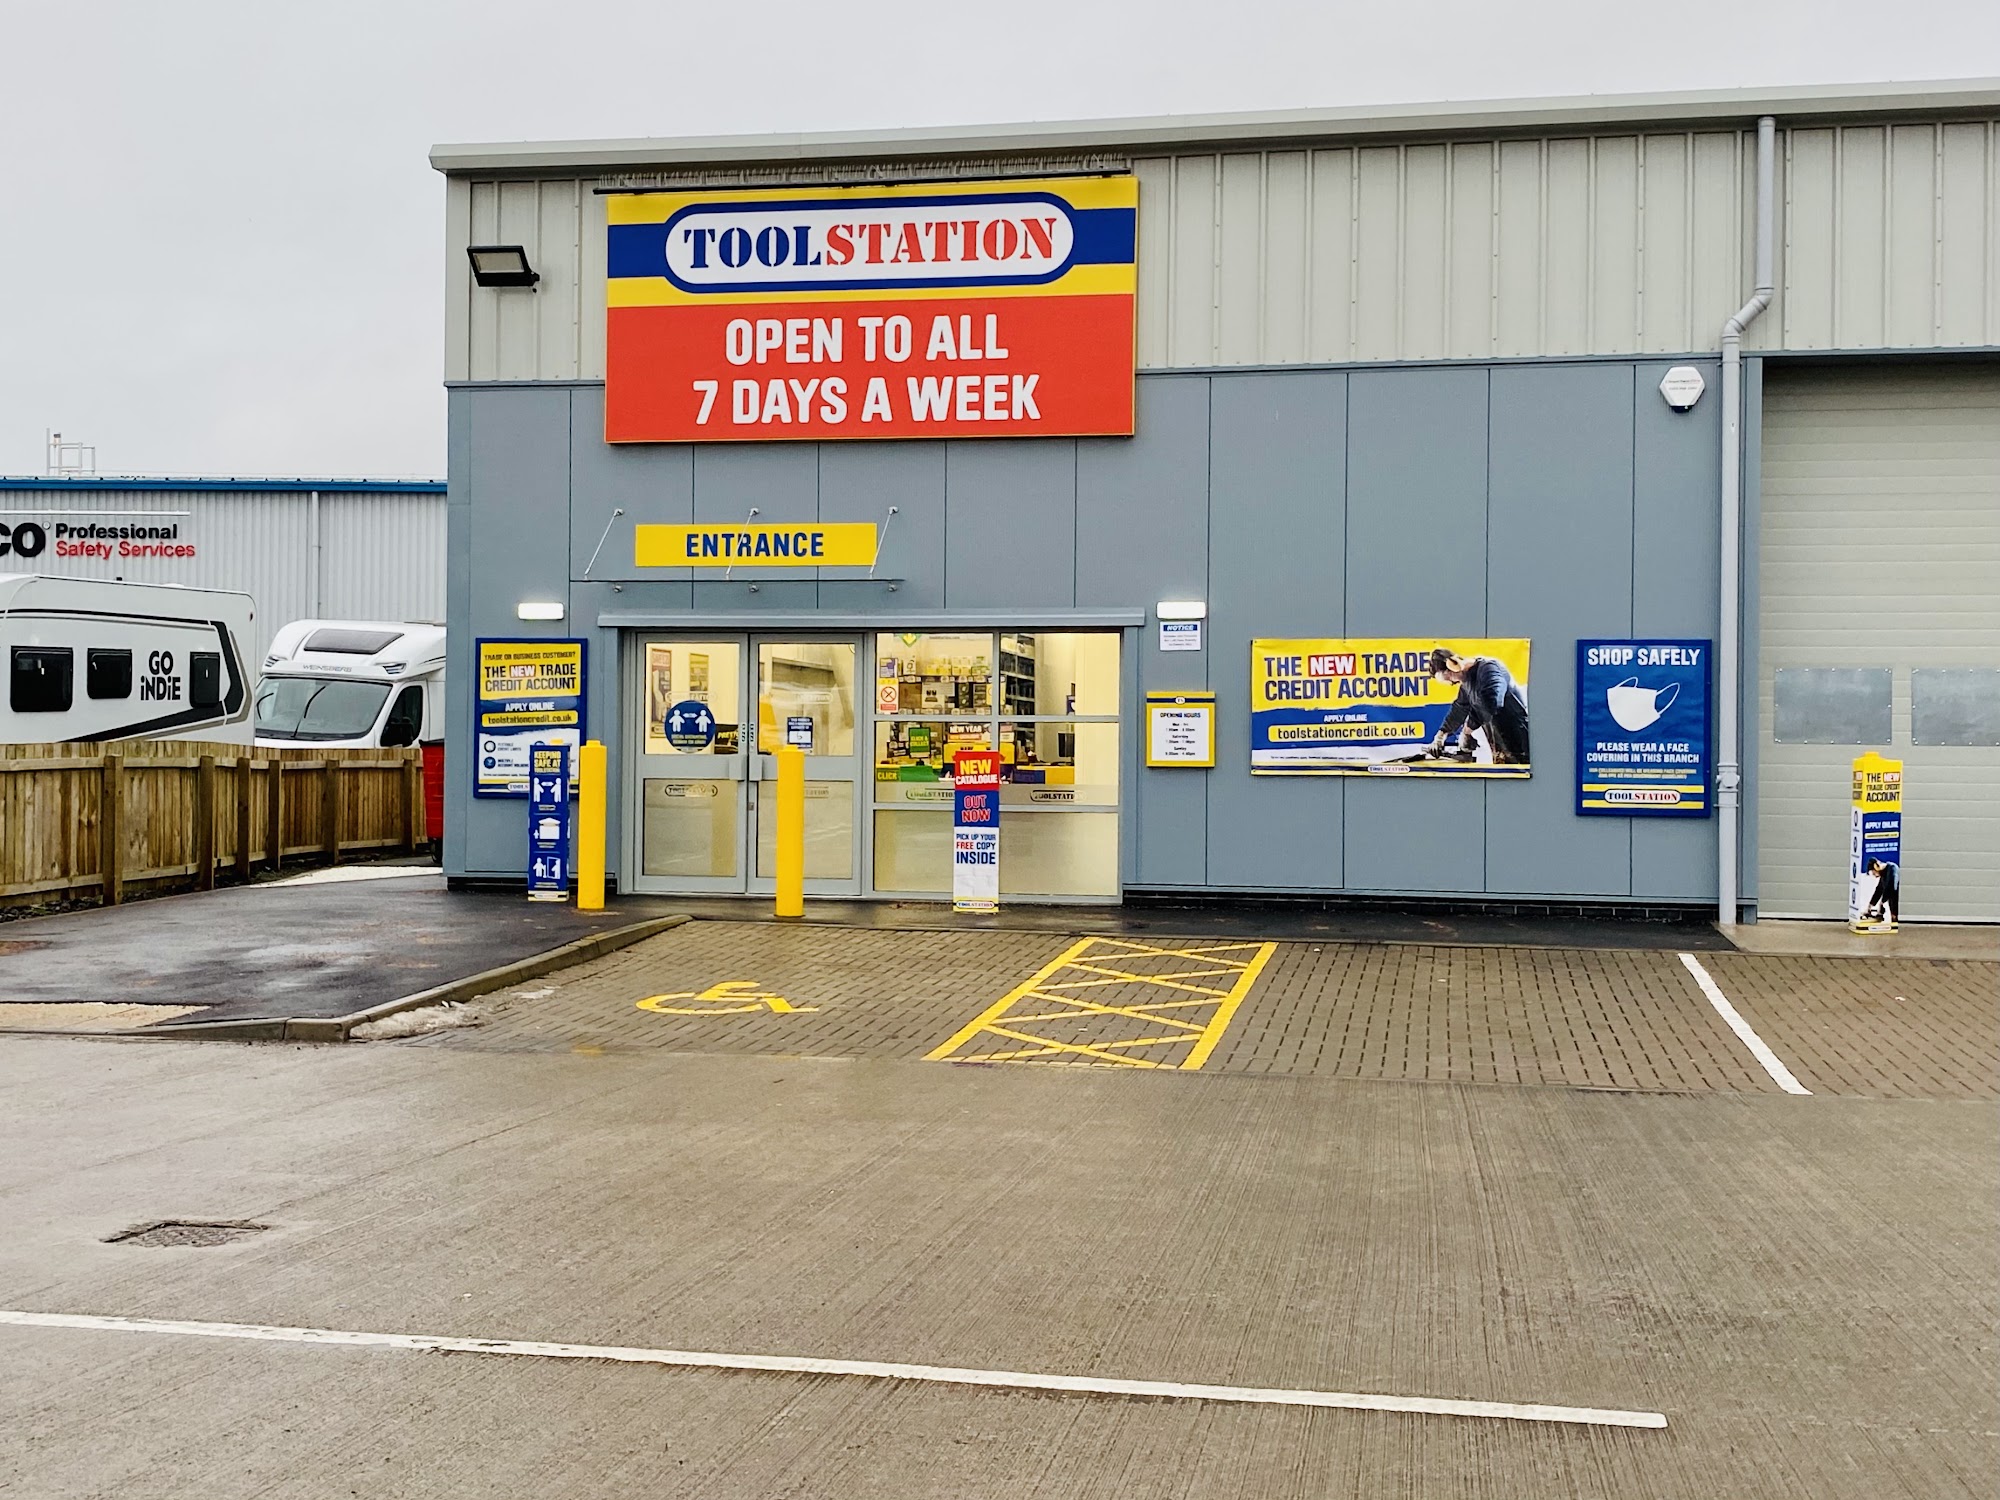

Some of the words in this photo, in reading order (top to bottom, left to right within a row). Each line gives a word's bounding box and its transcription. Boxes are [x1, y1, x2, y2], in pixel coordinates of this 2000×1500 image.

[684, 217, 1056, 268] TOOLSTATION
[725, 317, 843, 366] OPEN
[858, 315, 912, 363] TO
[926, 314, 1009, 361] ALL
[692, 380, 720, 425] 7
[732, 377, 848, 424] DAYS
[861, 377, 893, 423] A
[906, 374, 1041, 422] WEEK
[56, 523, 178, 540] Professional
[56, 541, 112, 560] Safety
[118, 541, 195, 557] Services
[686, 532, 824, 559] ENTRANCE
[148, 650, 174, 675] GO
[542, 651, 576, 659] CUSTOMER?
[1587, 648, 1633, 666] SHOP
[1637, 648, 1701, 666] SAFELY
[485, 666, 506, 678] THE
[511, 665, 535, 677] NEW
[539, 663, 576, 676] TRADE
[1264, 656, 1302, 677] THE
[1310, 656, 1355, 675] NEW
[1362, 652, 1430, 673] TRADE
[485, 679, 523, 692] CREDIT
[526, 677, 576, 690] ACCOUNT
[1265, 678, 1331, 700] CREDIT
[1338, 675, 1431, 698] ACCOUNT
[505, 703, 527, 712] APPLY
[528, 702, 555, 711] ONLINE
[488, 714, 572, 724] toolstationcredit.co.uk
[1345, 714, 1367, 722] ONLINE
[965, 725, 982, 733] YEAR
[1278, 725, 1416, 740] toolstationcredit.co.uk
[1597, 742, 1629, 752] PLEASE
[1631, 743, 1657, 752] WEAR
[1658, 743, 1665, 752] A
[1667, 743, 1689, 752] FACE
[1587, 753, 1629, 762] COVERING
[1631, 753, 1640, 762] IN
[1642, 753, 1662, 763] THIS
[1664, 754, 1699, 763] BRANCH
[960, 759, 992, 775] NEW
[877, 772, 897, 780] CLICK
[955, 774, 998, 785] CATALOGUE
[1866, 773, 1881, 783] THE
[1883, 772, 1900, 782] NEW
[964, 794, 987, 809] OUT
[1608, 792, 1678, 801] TOOLSTATION
[1866, 792, 1900, 802] ACCOUNT
[961, 808, 991, 823] NOW
[1865, 821, 1881, 829] APPLY
[976, 842, 996, 850] COPY
[956, 851, 996, 864] INSIDE
